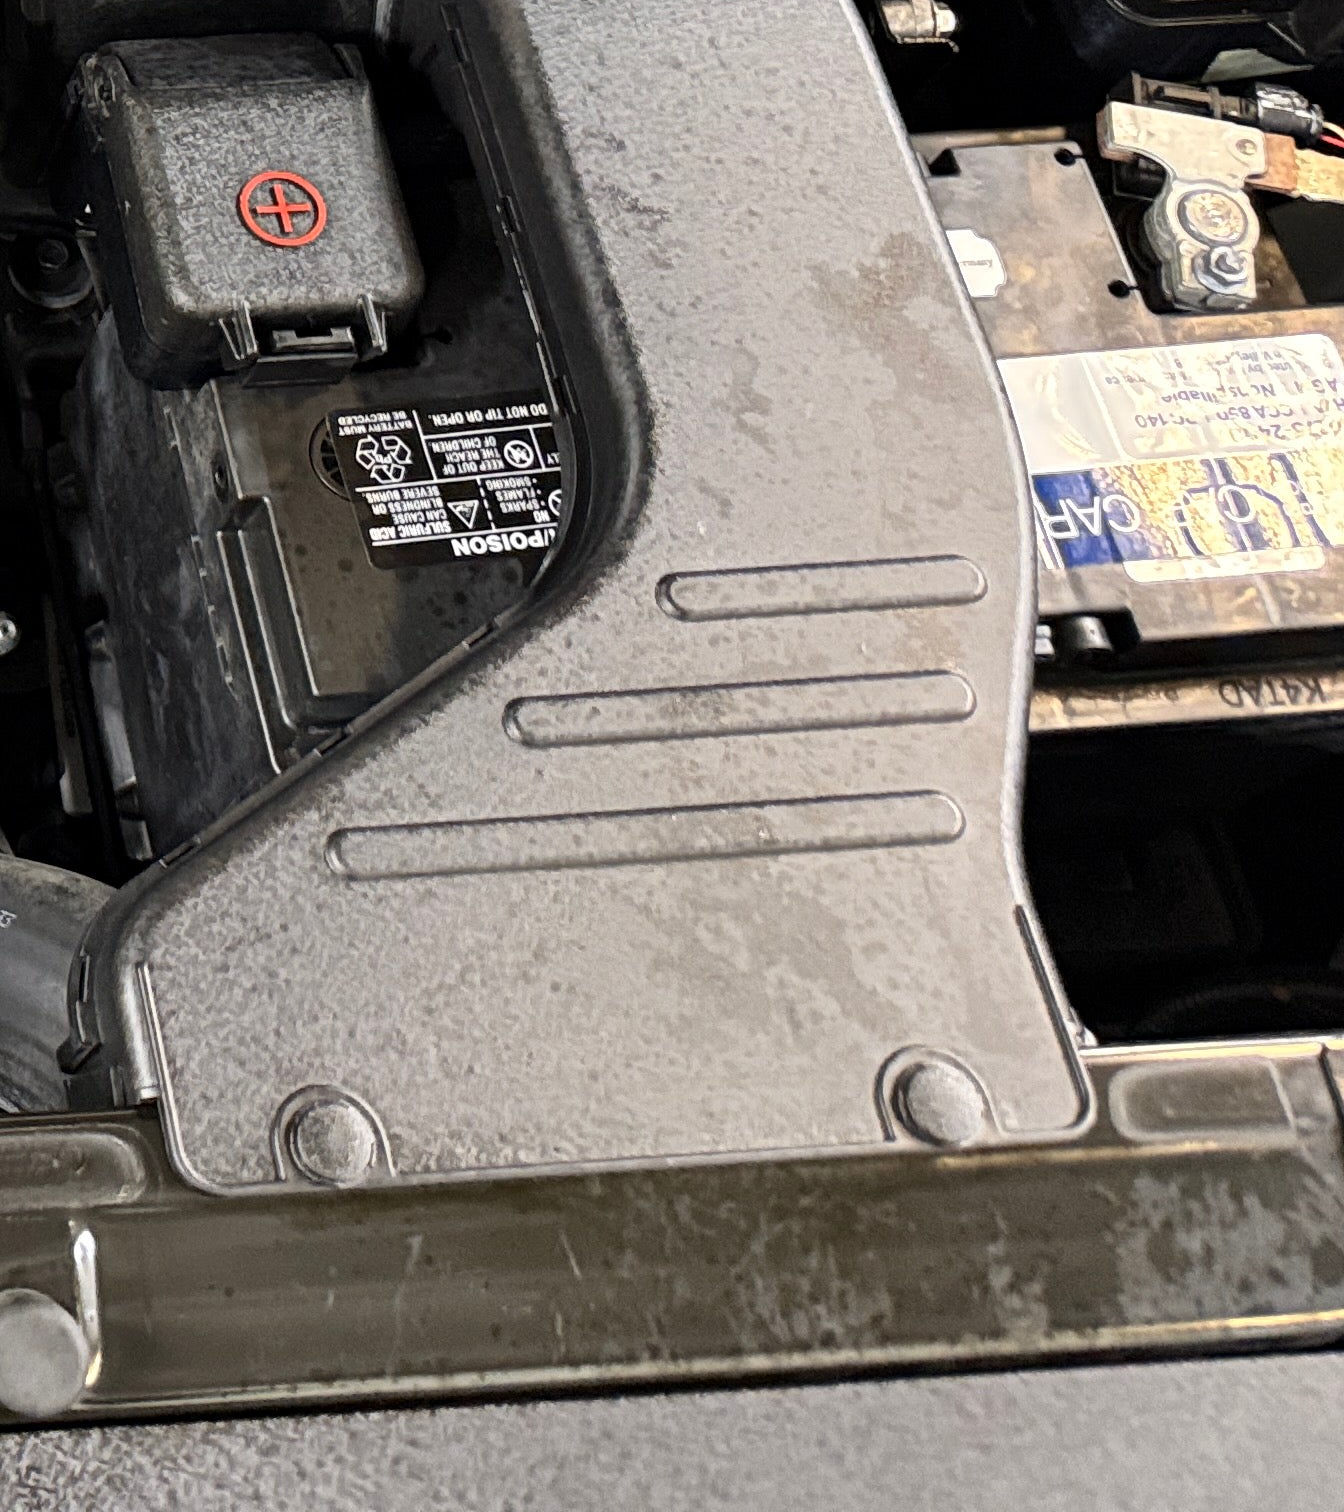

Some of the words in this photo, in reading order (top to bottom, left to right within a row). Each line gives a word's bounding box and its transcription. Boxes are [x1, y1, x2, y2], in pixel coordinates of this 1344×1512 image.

[466, 408, 483, 422] OR
[485, 406, 504, 421] TIP
[506, 404, 529, 419] NOT
[532, 403, 548, 416] DO
[339, 424, 366, 436] MUST
[368, 421, 413, 434] BATTERY
[445, 450, 480, 462] REACH
[483, 447, 502, 459] THE
[442, 464, 456, 475] OF
[458, 462, 478, 474] OUT
[480, 459, 505, 472] KEEP
[485, 477, 532, 490] SMOKING
[401, 486, 441, 500] SEVERE
[371, 503, 388, 515] OR
[389, 497, 444, 514] BLINDNESS
[500, 500, 540, 514] SPARKS
[393, 511, 422, 525] CAUSE
[425, 509, 447, 523] CAN
[533, 510, 550, 523] NO
[369, 526, 396, 541] ACID
[399, 521, 452, 538] SULFURIC
